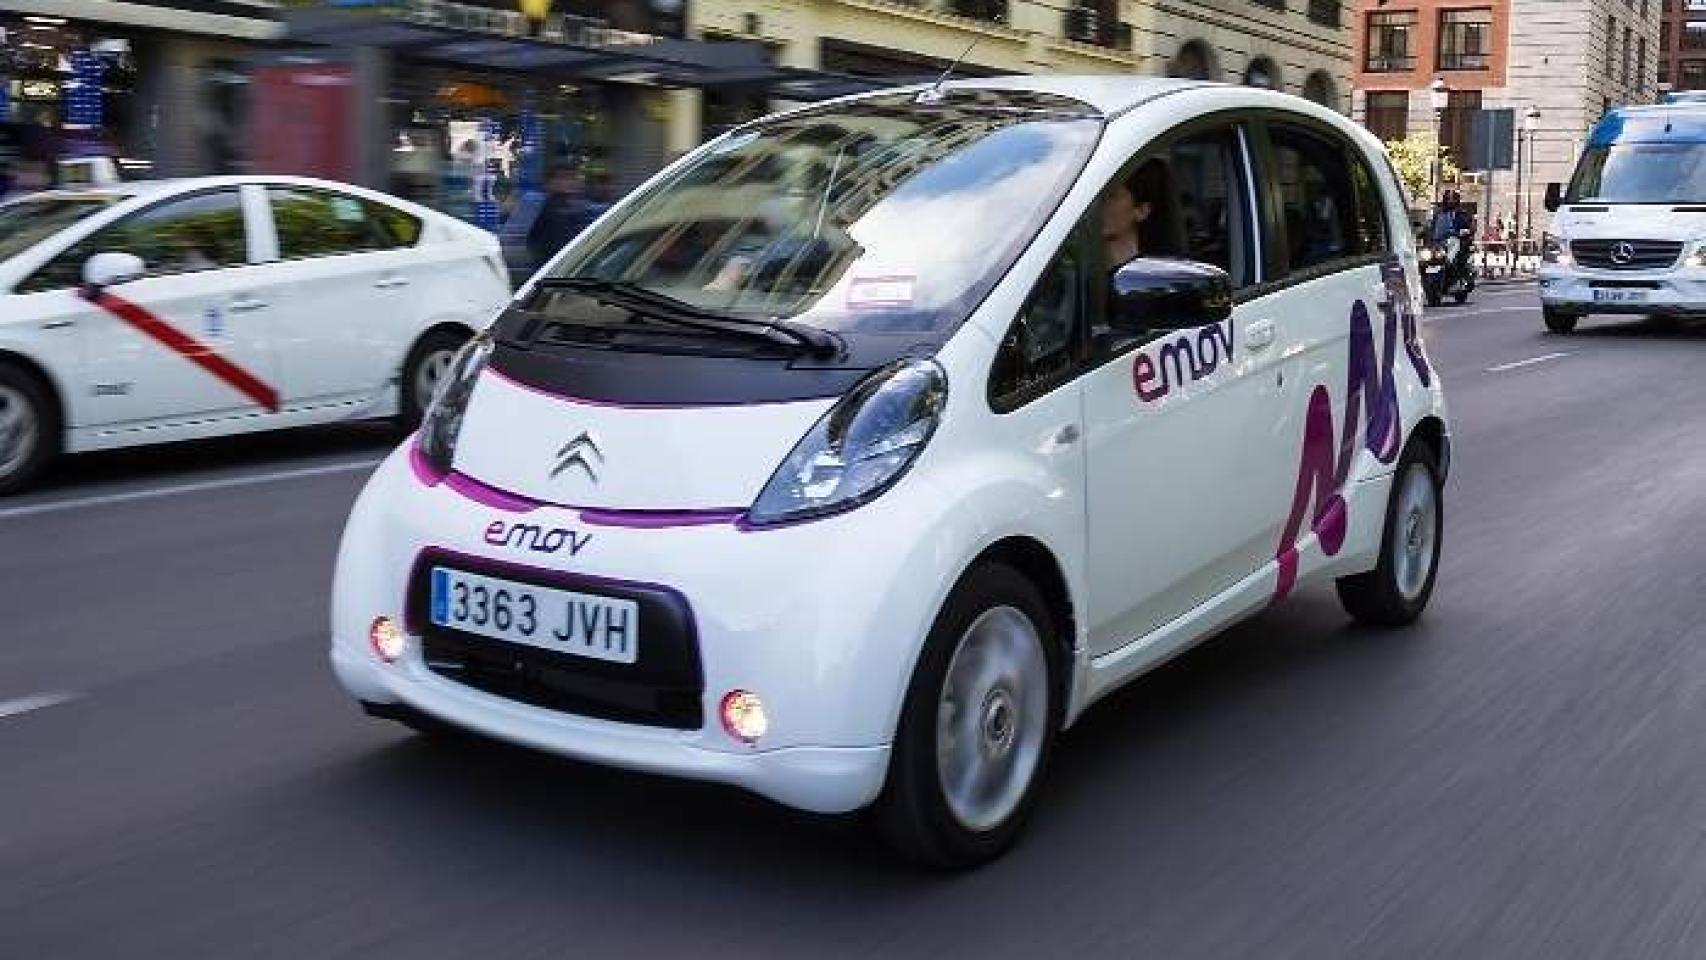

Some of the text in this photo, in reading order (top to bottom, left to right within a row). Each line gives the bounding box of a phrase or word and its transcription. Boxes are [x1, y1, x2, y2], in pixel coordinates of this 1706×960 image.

[1133, 318, 1234, 402] emov
[485, 521, 592, 555] emov
[453, 581, 629, 653] 3363 JVH
